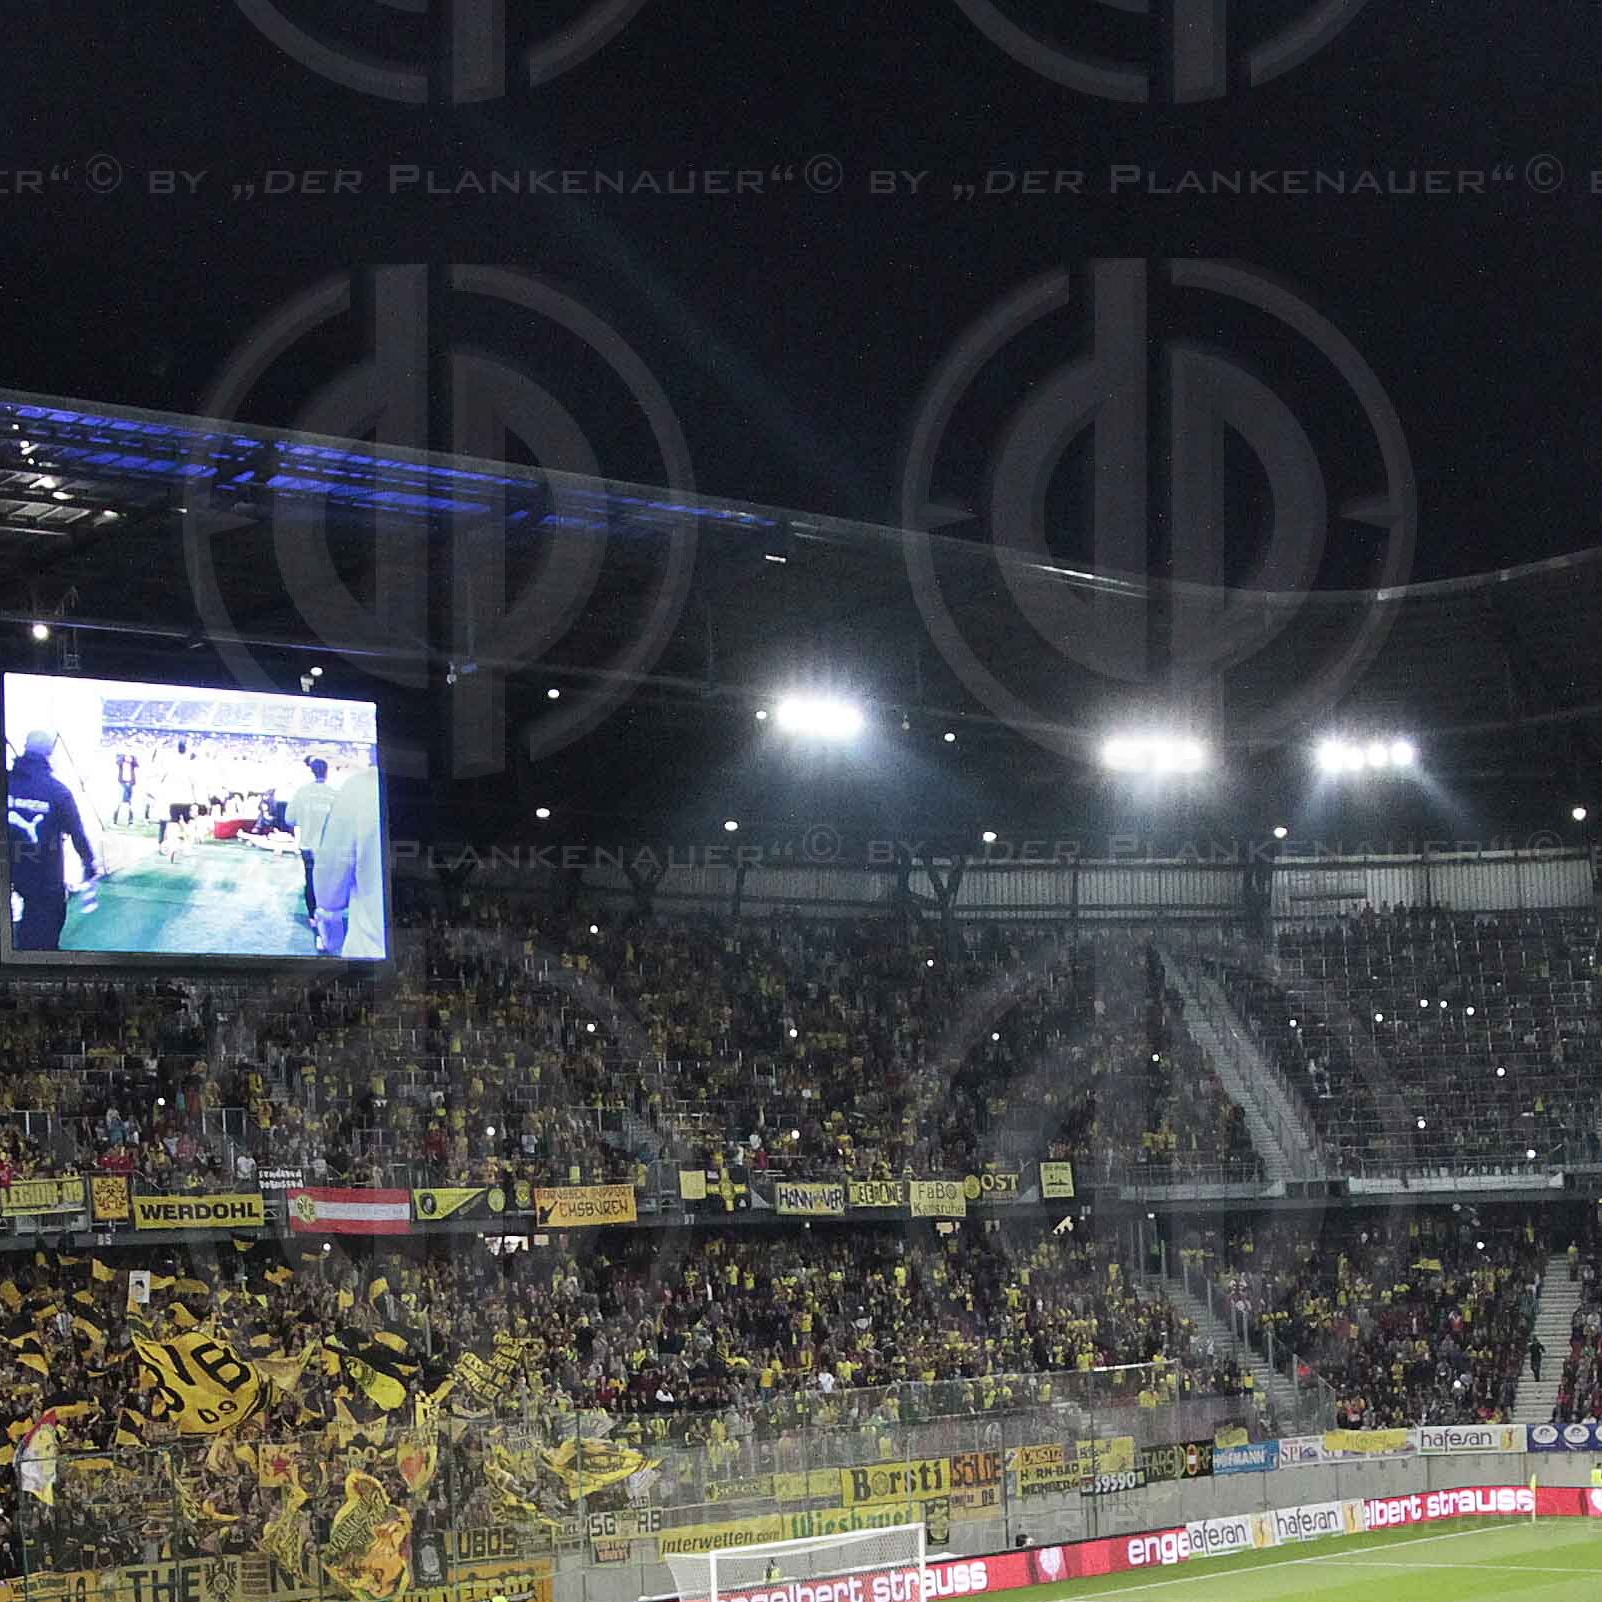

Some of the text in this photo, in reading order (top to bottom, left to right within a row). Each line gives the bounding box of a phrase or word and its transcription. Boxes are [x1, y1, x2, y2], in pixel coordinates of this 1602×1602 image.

[981, 1174, 1019, 1190] OST
[140, 1201, 261, 1220] WERDOHL
[1421, 1429, 1493, 1453] hafesan
[1427, 1488, 1535, 1517] strauss
[1277, 1506, 1338, 1541] hafesan
